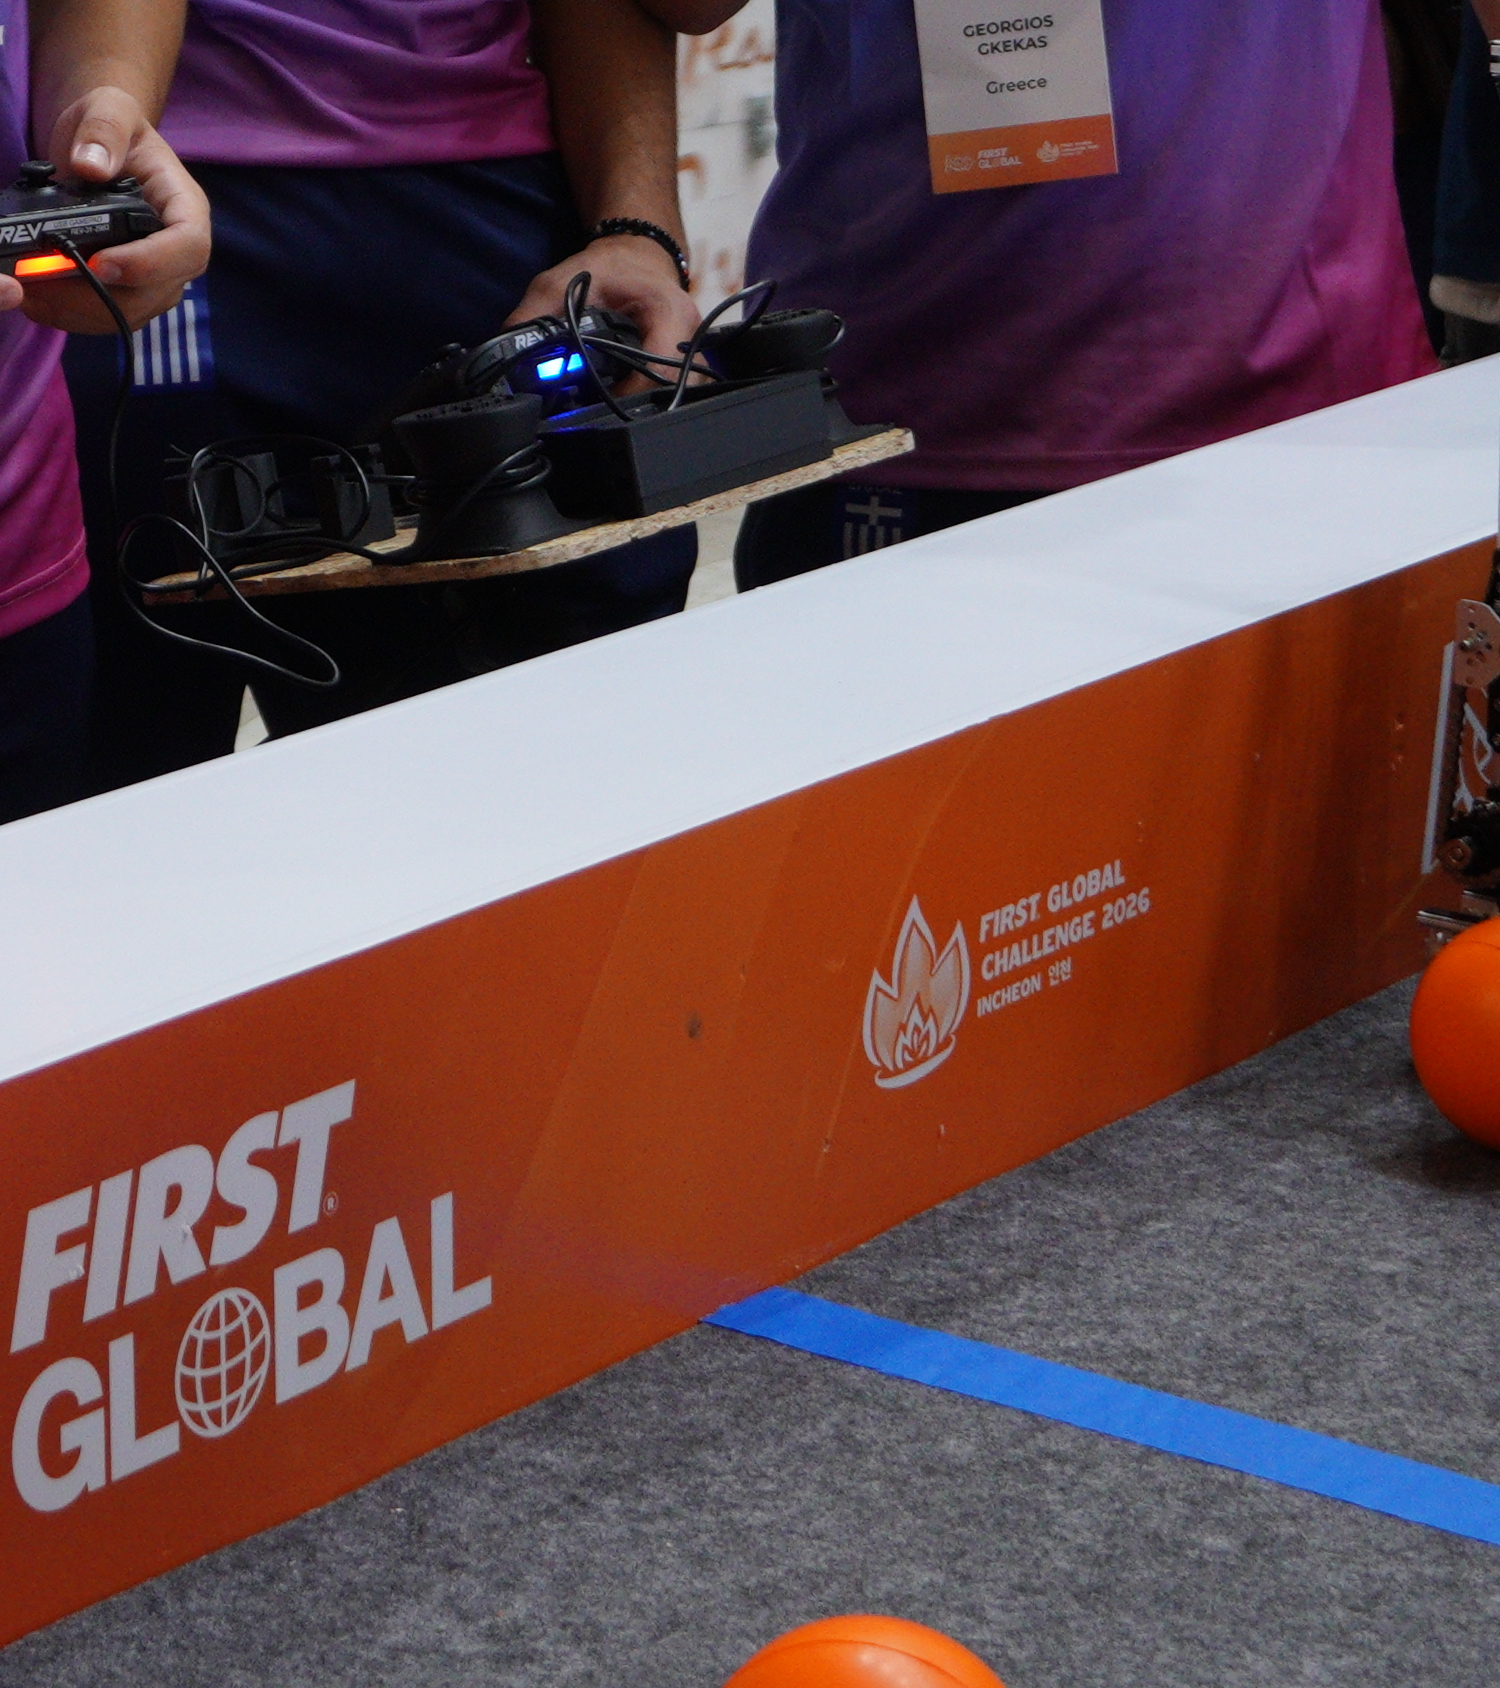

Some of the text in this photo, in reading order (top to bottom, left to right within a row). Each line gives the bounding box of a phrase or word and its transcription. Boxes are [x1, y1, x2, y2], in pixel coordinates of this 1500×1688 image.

[963, 14, 1054, 38] GEORGIOS
[977, 35, 1048, 56] GKEKAS
[985, 76, 1047, 95] Greece
[978, 859, 1126, 943] FIRST GLOBAL
[981, 887, 1151, 981] CHALLENGE 2026
[976, 972, 1042, 1018] INCHEON
[9, 1078, 356, 1354] FIRST
[11, 1192, 492, 1512] GLOBAL
